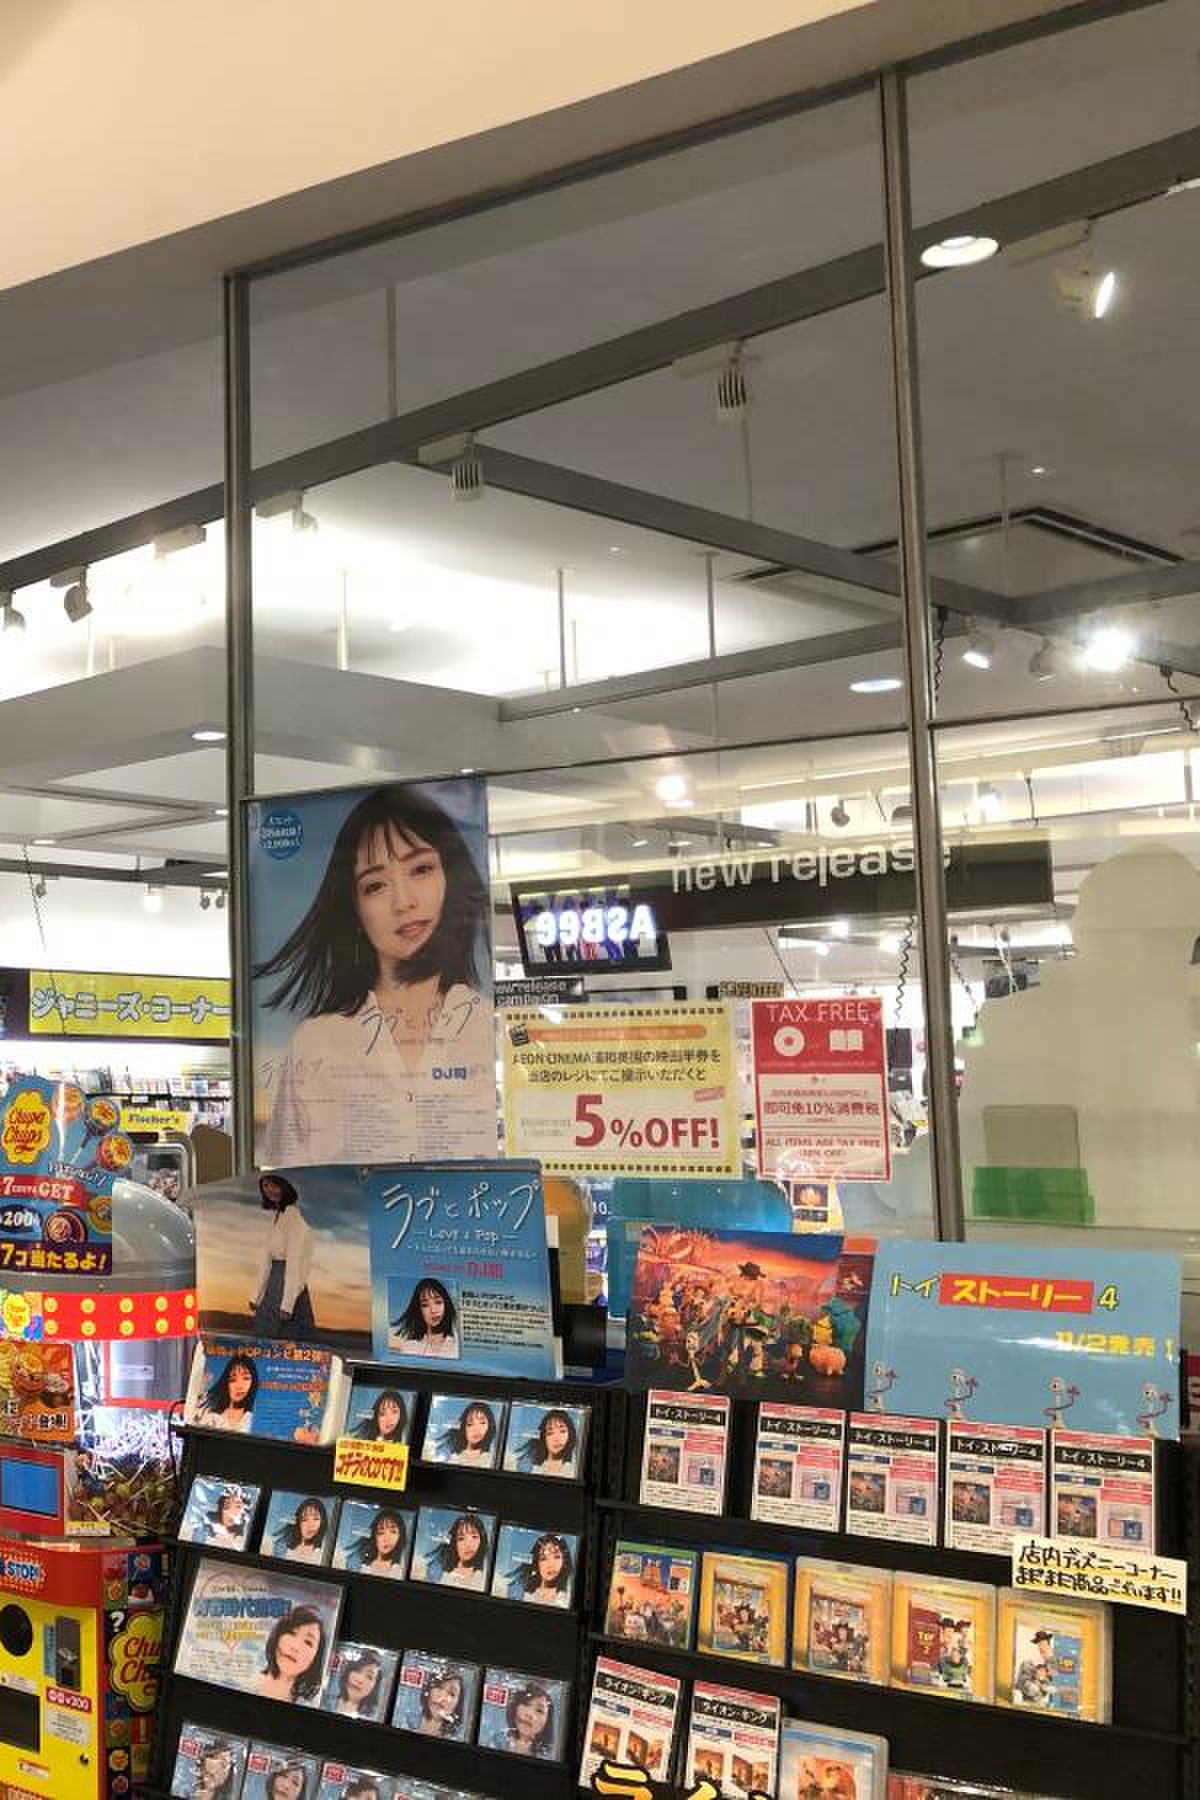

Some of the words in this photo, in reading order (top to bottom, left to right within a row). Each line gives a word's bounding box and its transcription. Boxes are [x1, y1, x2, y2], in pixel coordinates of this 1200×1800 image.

[769, 846, 951, 887] releas
[765, 1004, 808, 1021] TAX
[816, 1003, 872, 1022] FREE
[38, 1181, 75, 1201] GET
[381, 1180, 543, 1249] ラブとポップ
[891, 1275, 940, 1299] トイ
[952, 1278, 1084, 1309] ストーリー
[1099, 1286, 1119, 1310] 4
[655, 1407, 721, 1424] トイ・ストーリー4
[766, 1420, 837, 1437] トイ・ストーリー4
[855, 1431, 931, 1450] トイ・ストーリー4
[1062, 1451, 1146, 1469] トイ・ストーリー4
[1018, 1539, 1179, 1580] 店内ディズニーコーナー
